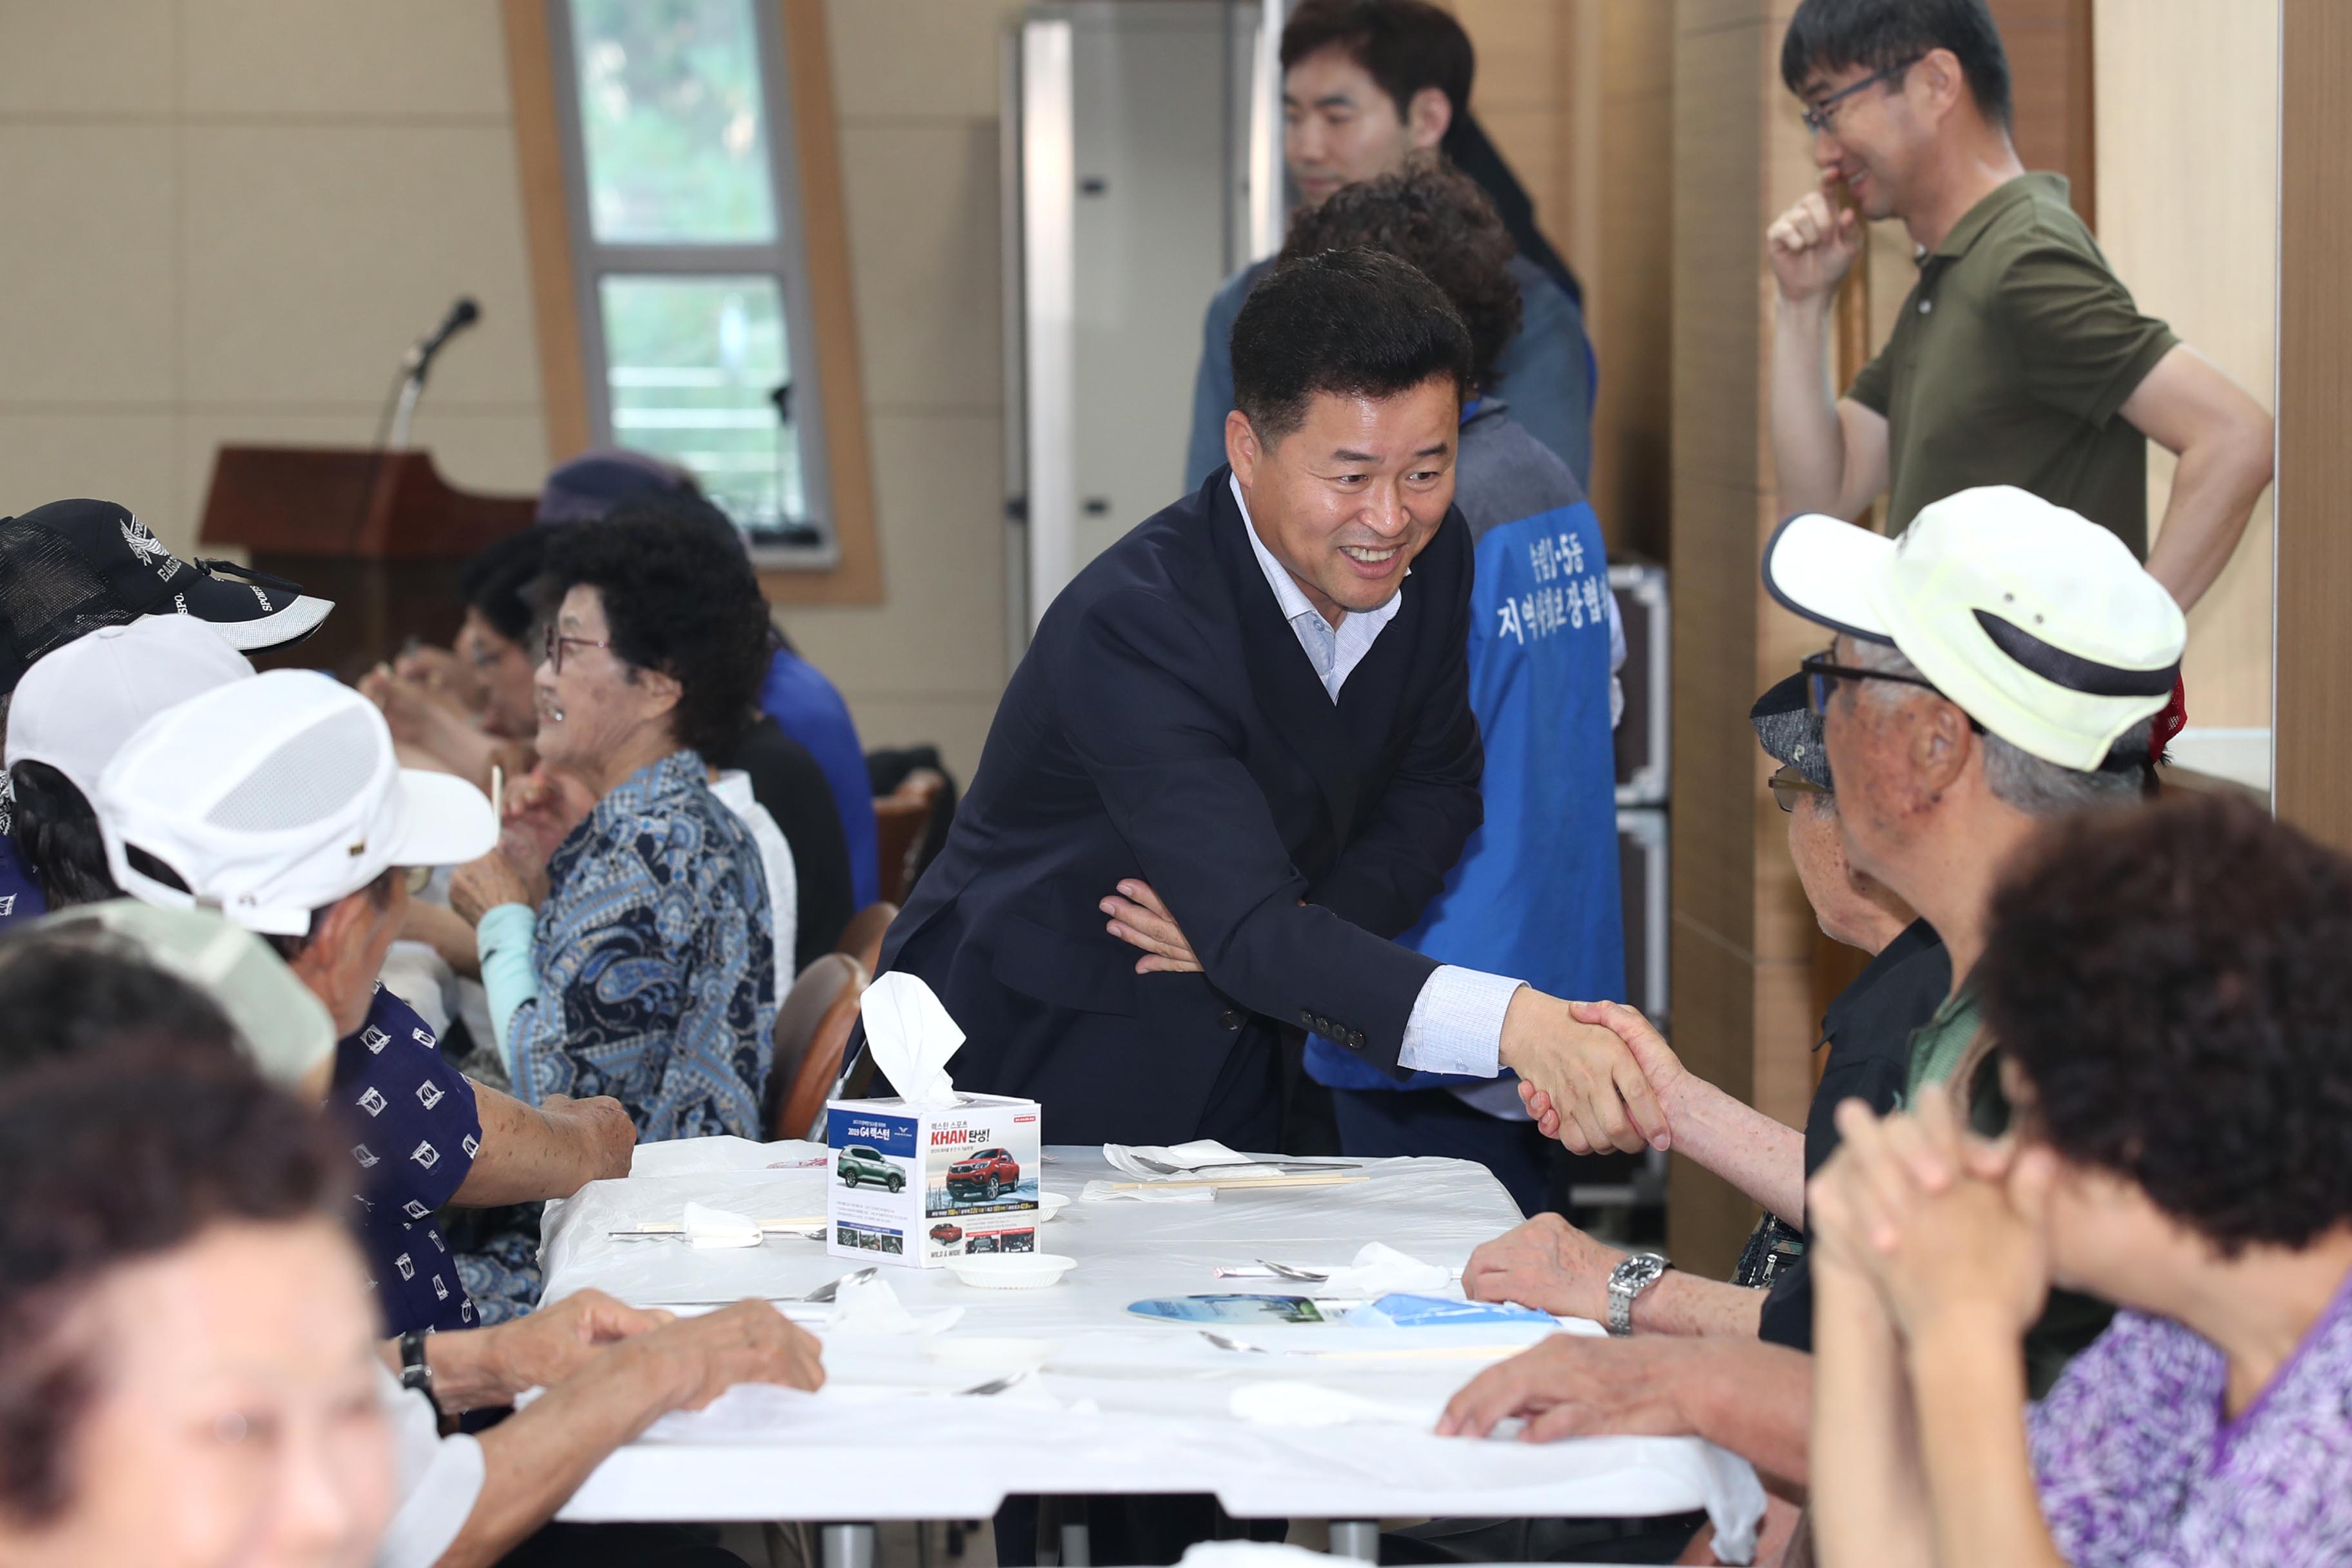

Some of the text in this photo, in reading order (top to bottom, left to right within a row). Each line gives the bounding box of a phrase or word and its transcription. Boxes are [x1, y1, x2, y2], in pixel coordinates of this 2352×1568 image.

[174, 593, 188, 614] SPO
[950, 1121, 968, 1129] 스포츠
[848, 1128, 859, 1136] 2019
[860, 1127, 869, 1137] G4
[870, 1128, 890, 1141] 렉스턴
[931, 1128, 990, 1145] KHAN 탄생!
